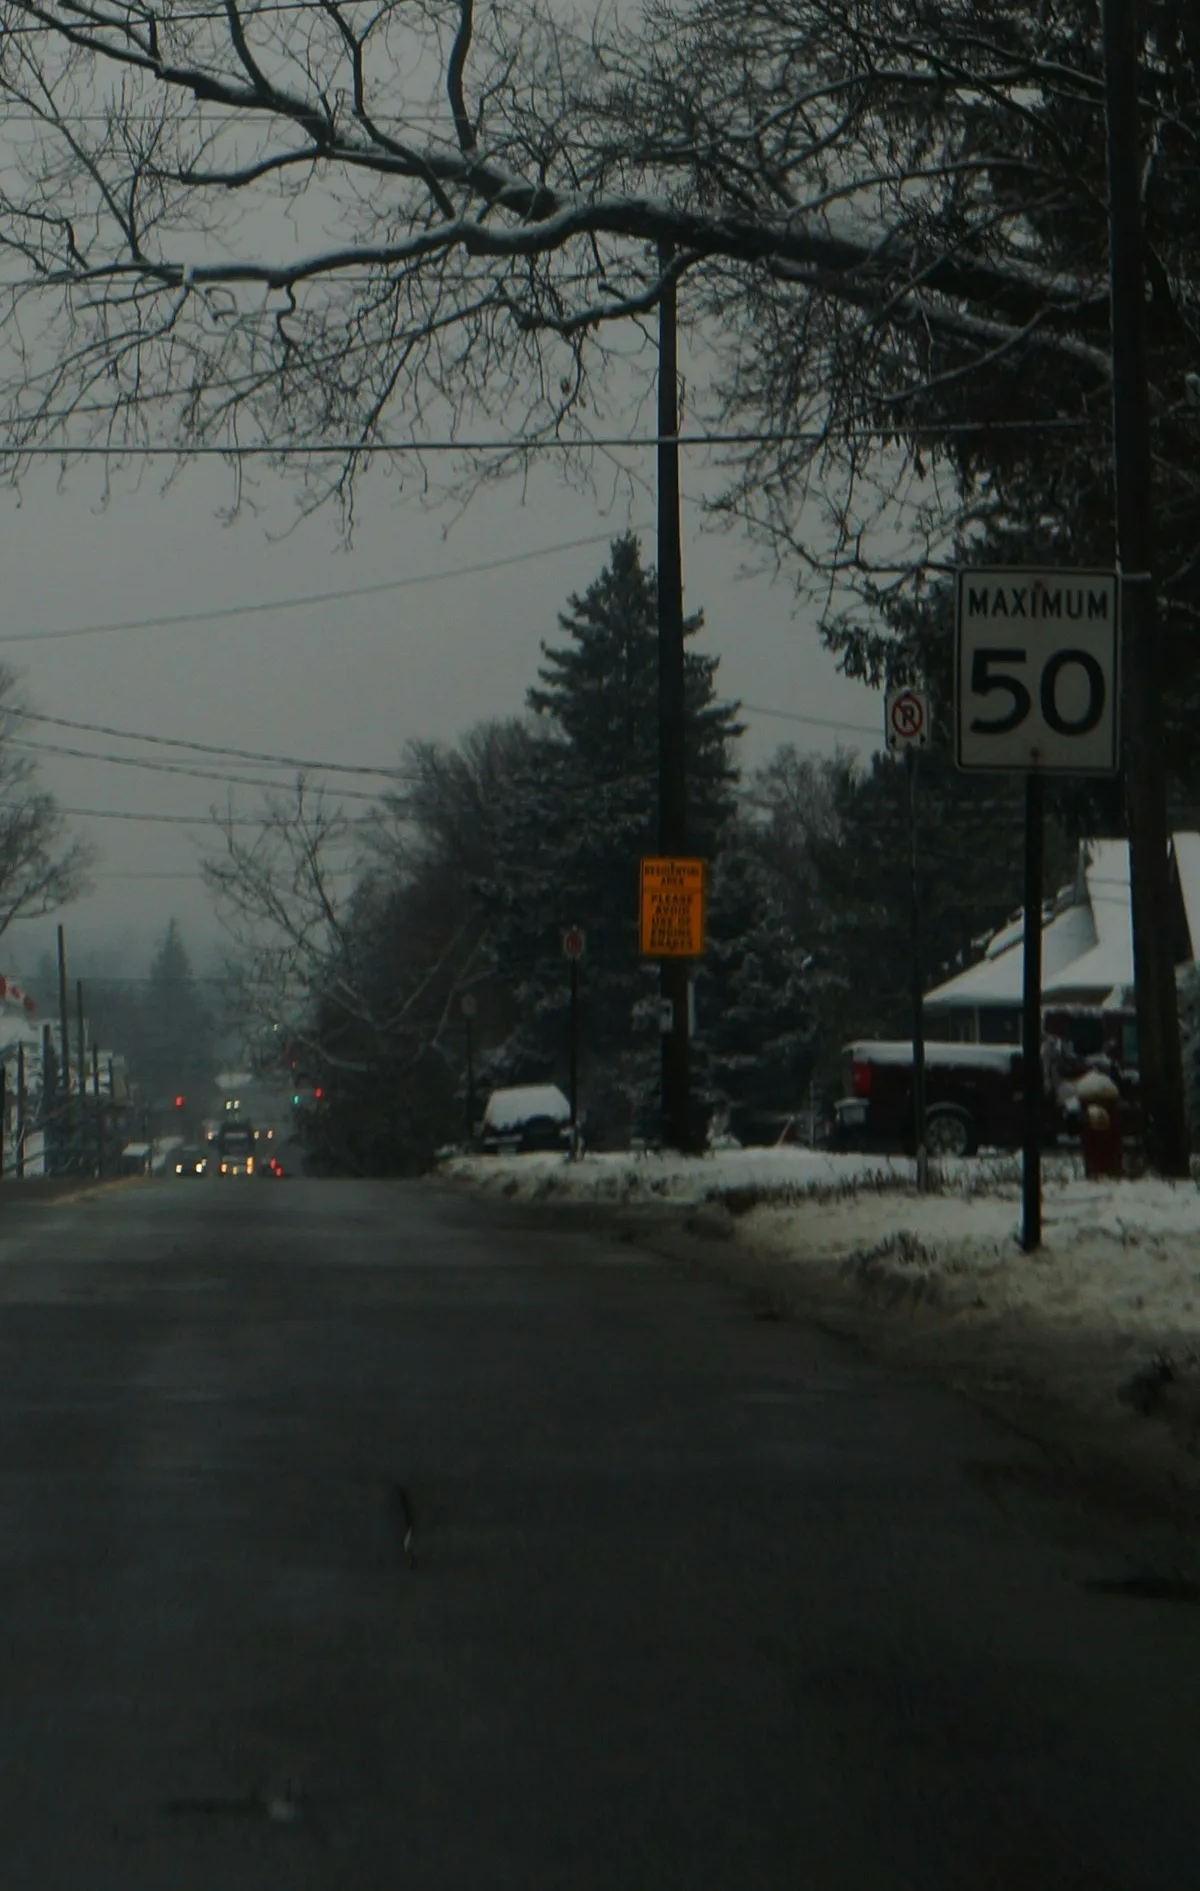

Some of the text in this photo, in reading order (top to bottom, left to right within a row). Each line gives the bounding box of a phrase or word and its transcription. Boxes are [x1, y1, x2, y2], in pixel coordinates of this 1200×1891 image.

[968, 588, 1108, 619] MAXIMUM
[970, 649, 1105, 736] 50
[660, 876, 684, 886] AREA
[651, 894, 692, 904] PLEASE
[655, 905, 689, 915] AVOID
[652, 916, 690, 926] USE OF
[651, 927, 691, 937] ENGINE
[650, 938, 693, 948] BRAKES
